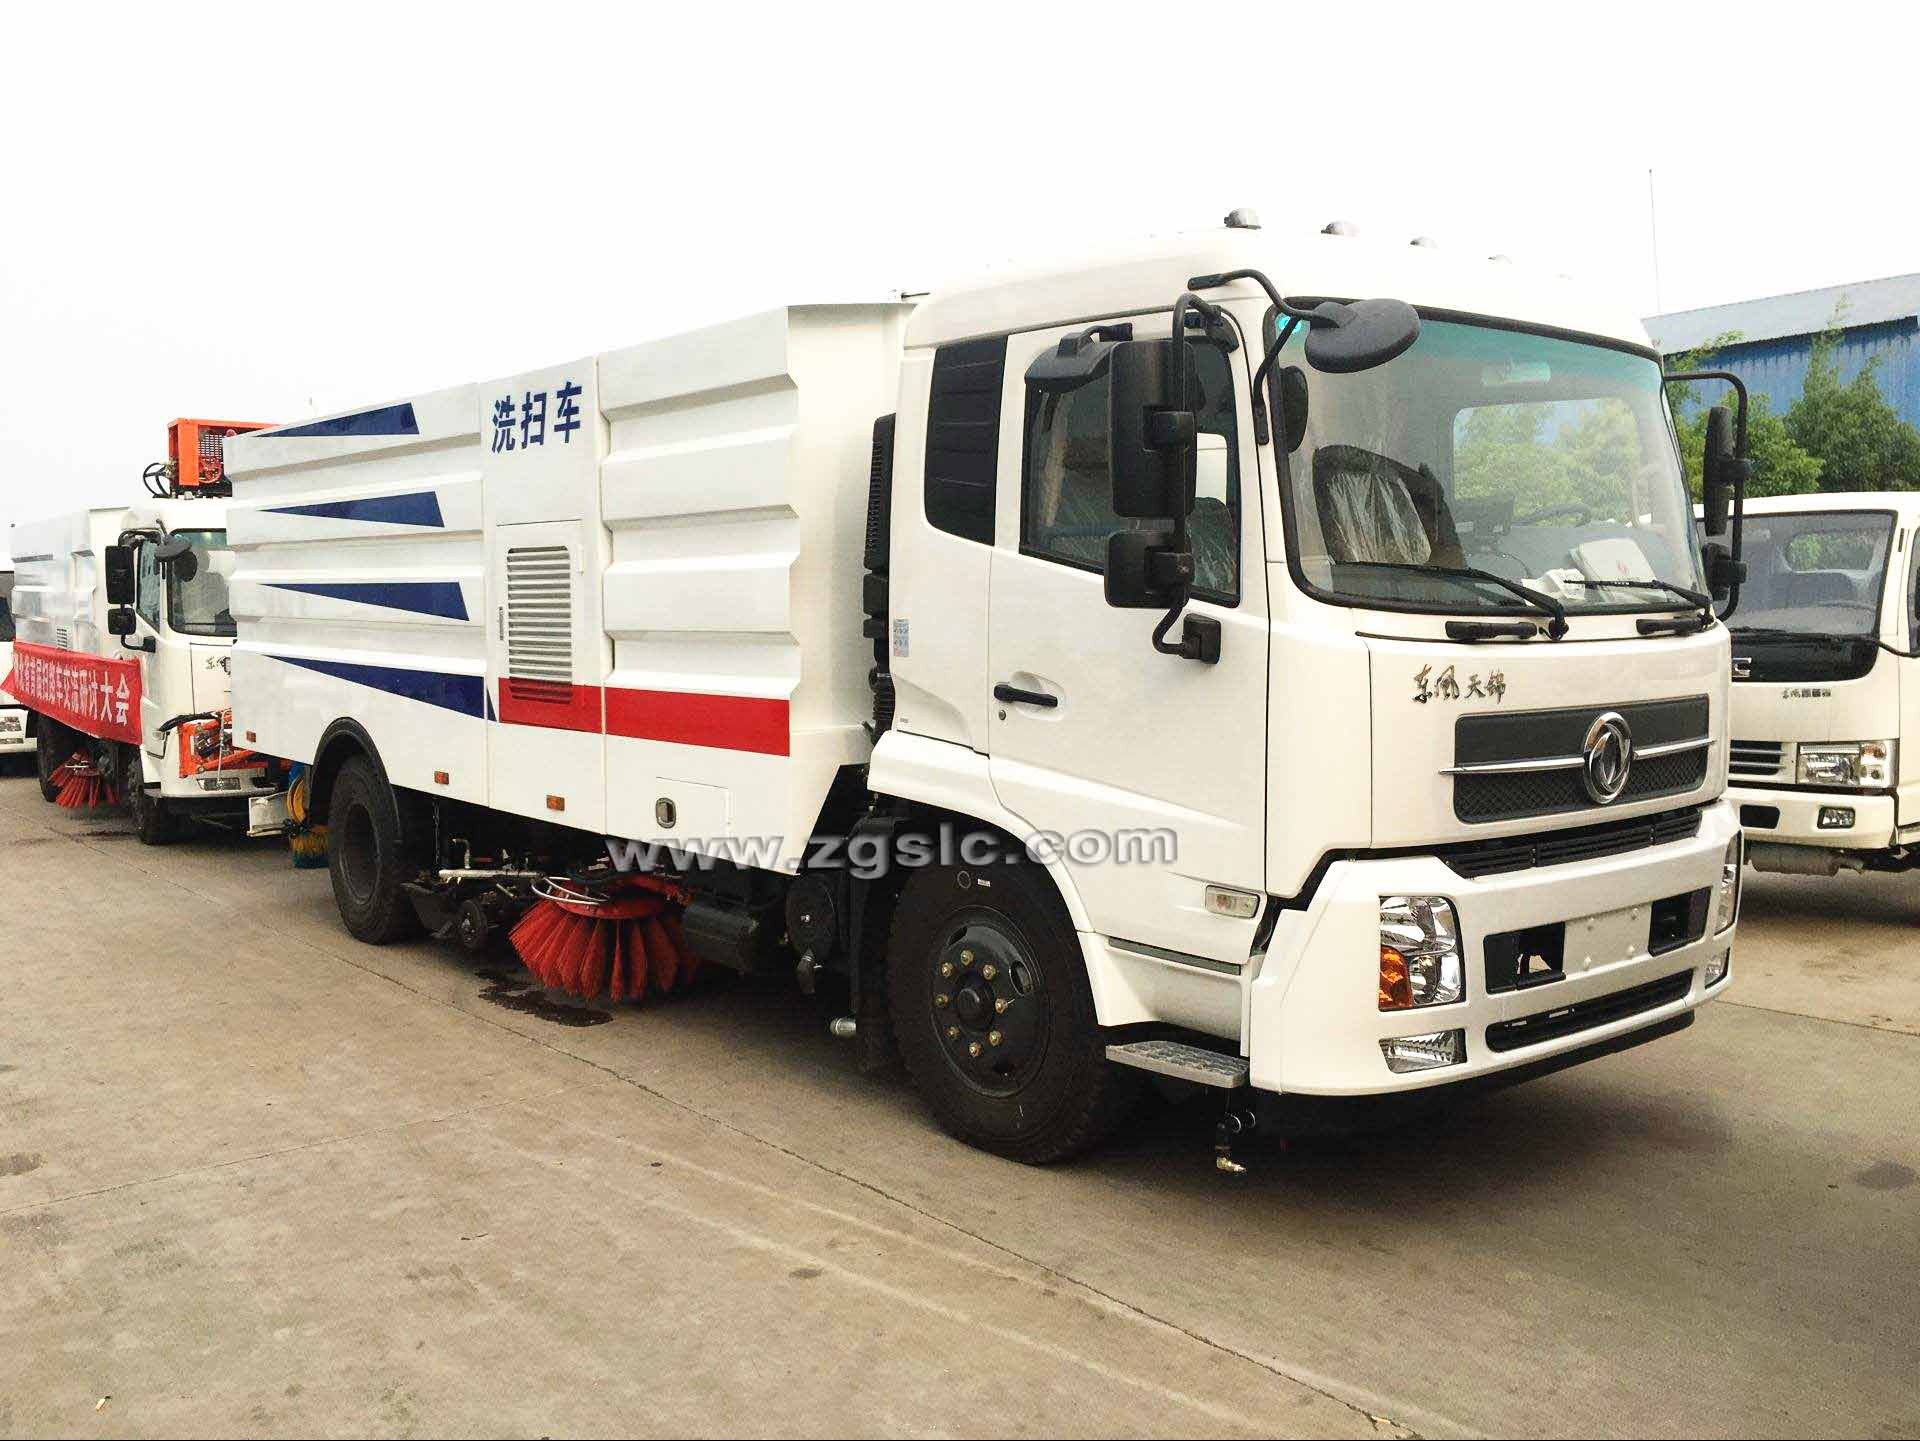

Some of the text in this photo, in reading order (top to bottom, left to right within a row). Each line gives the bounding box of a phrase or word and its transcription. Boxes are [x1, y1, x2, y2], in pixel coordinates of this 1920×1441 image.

[491, 381, 582, 454] 洗扫车
[1412, 663, 1506, 704] 东风天锦
